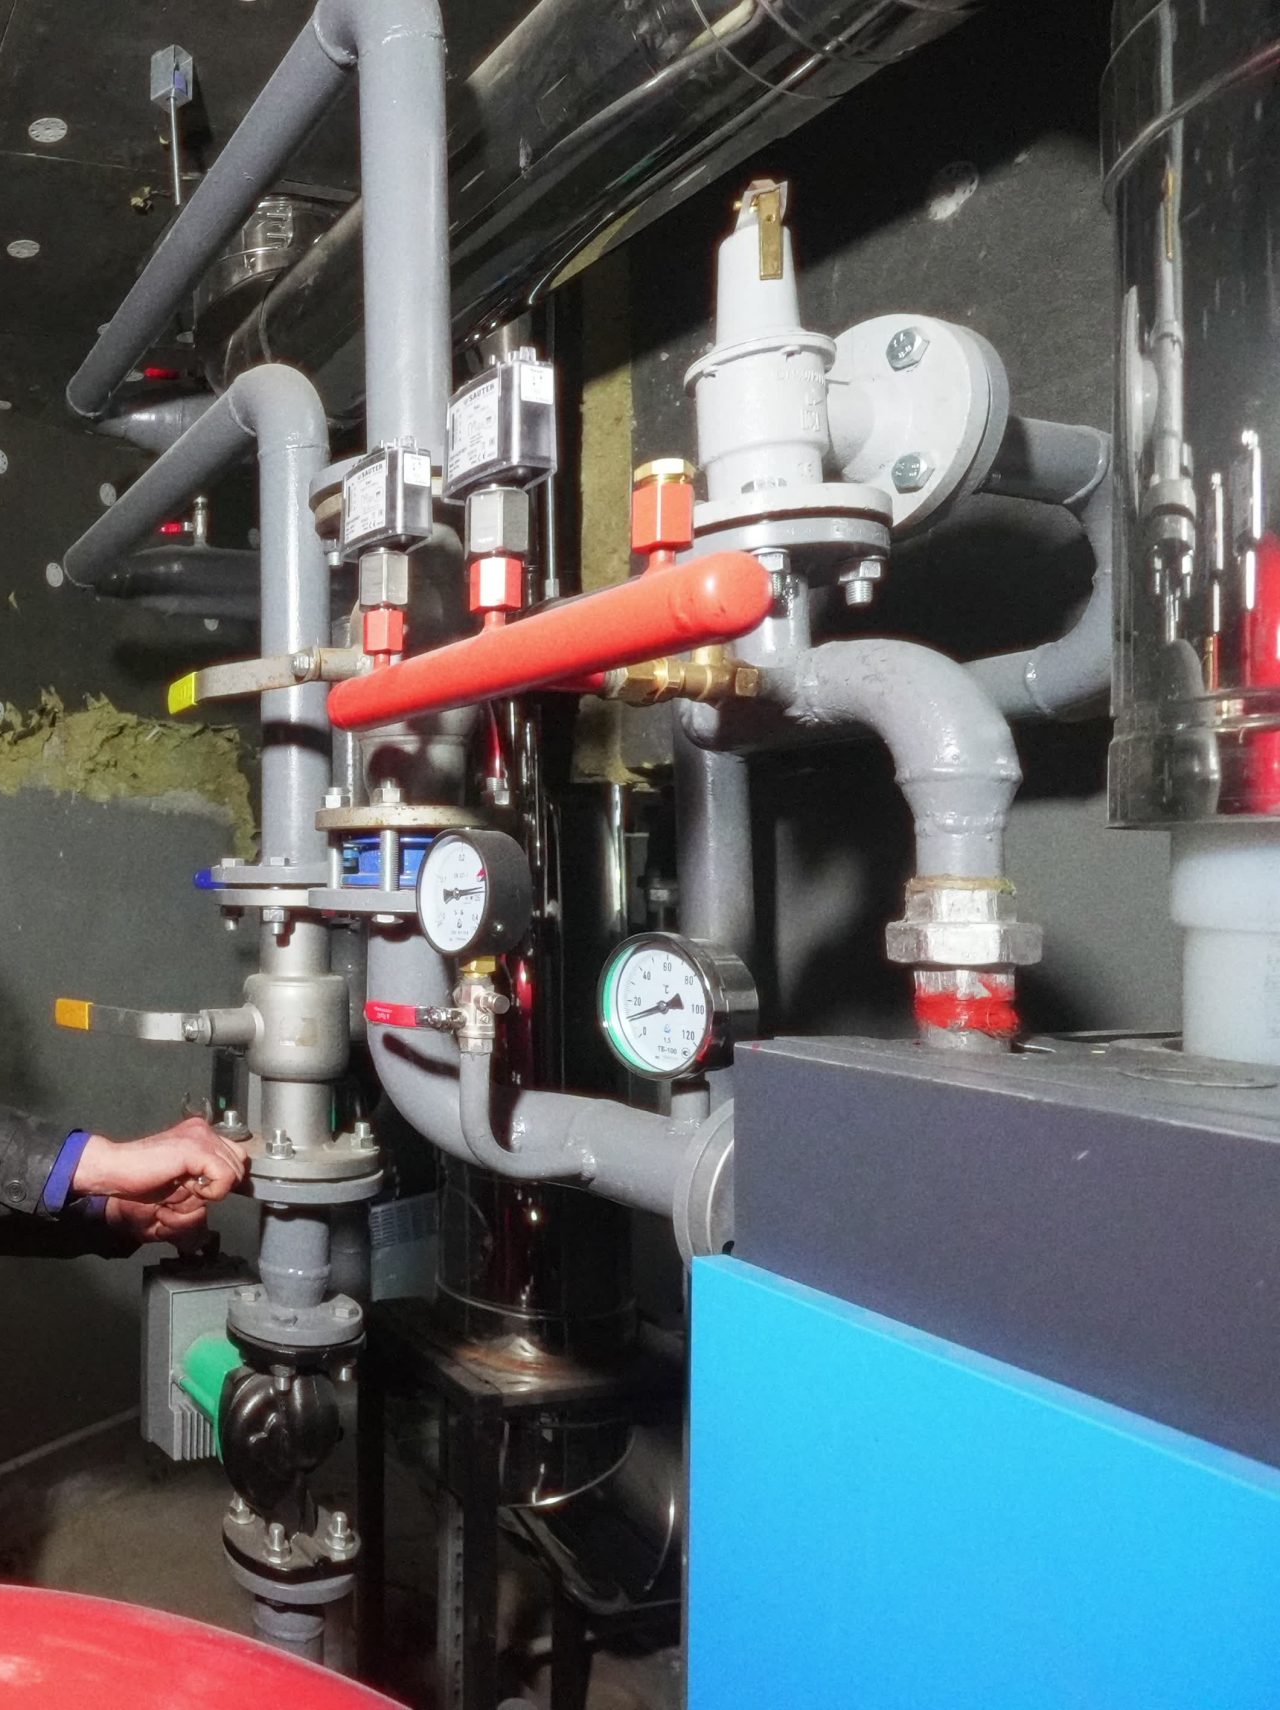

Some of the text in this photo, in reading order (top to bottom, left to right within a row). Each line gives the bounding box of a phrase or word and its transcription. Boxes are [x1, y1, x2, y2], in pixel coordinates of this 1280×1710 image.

[469, 382, 495, 403] SAUTER
[361, 463, 383, 478] SAUTER
[663, 962, 672, 972] 60
[643, 971, 651, 981] 40
[685, 975, 693, 985] 80
[633, 996, 642, 1007] 20
[692, 1004, 704, 1014] 100
[682, 1029, 695, 1041] 120
